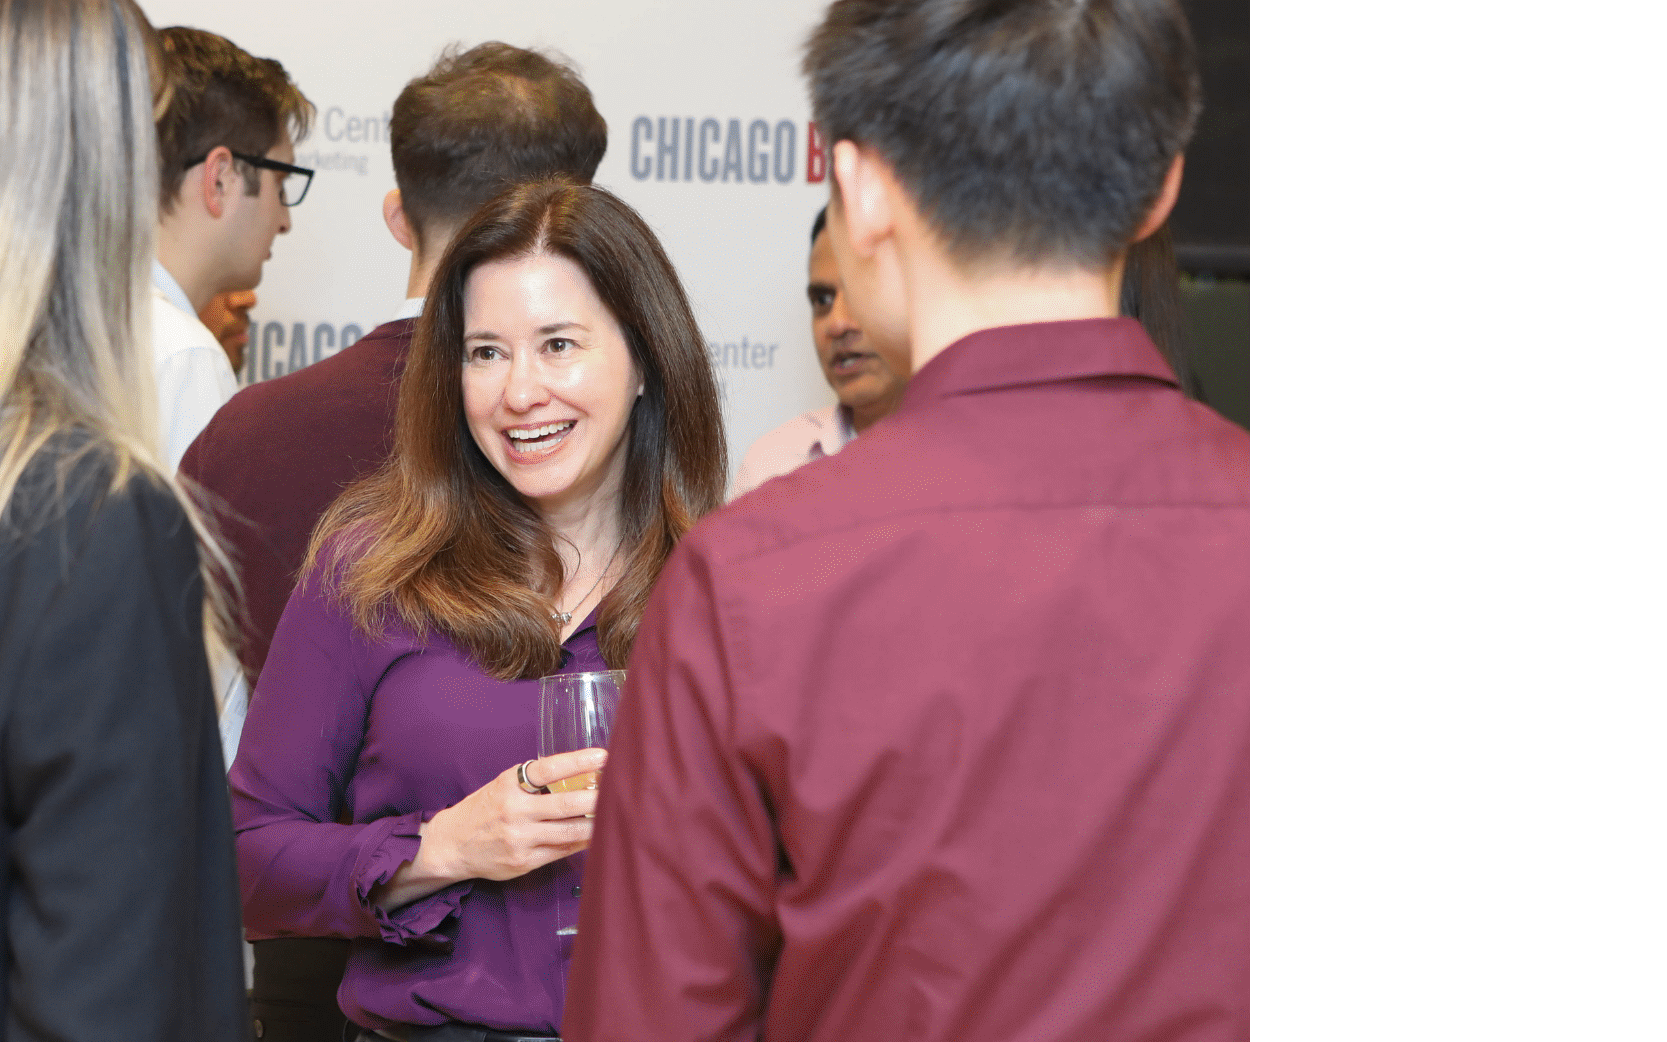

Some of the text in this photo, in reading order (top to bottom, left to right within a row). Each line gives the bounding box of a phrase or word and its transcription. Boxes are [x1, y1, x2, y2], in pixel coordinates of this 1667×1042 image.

[324, 106, 392, 143] Cent
[297, 150, 368, 175] arketing
[630, 115, 796, 184] CHICAGO
